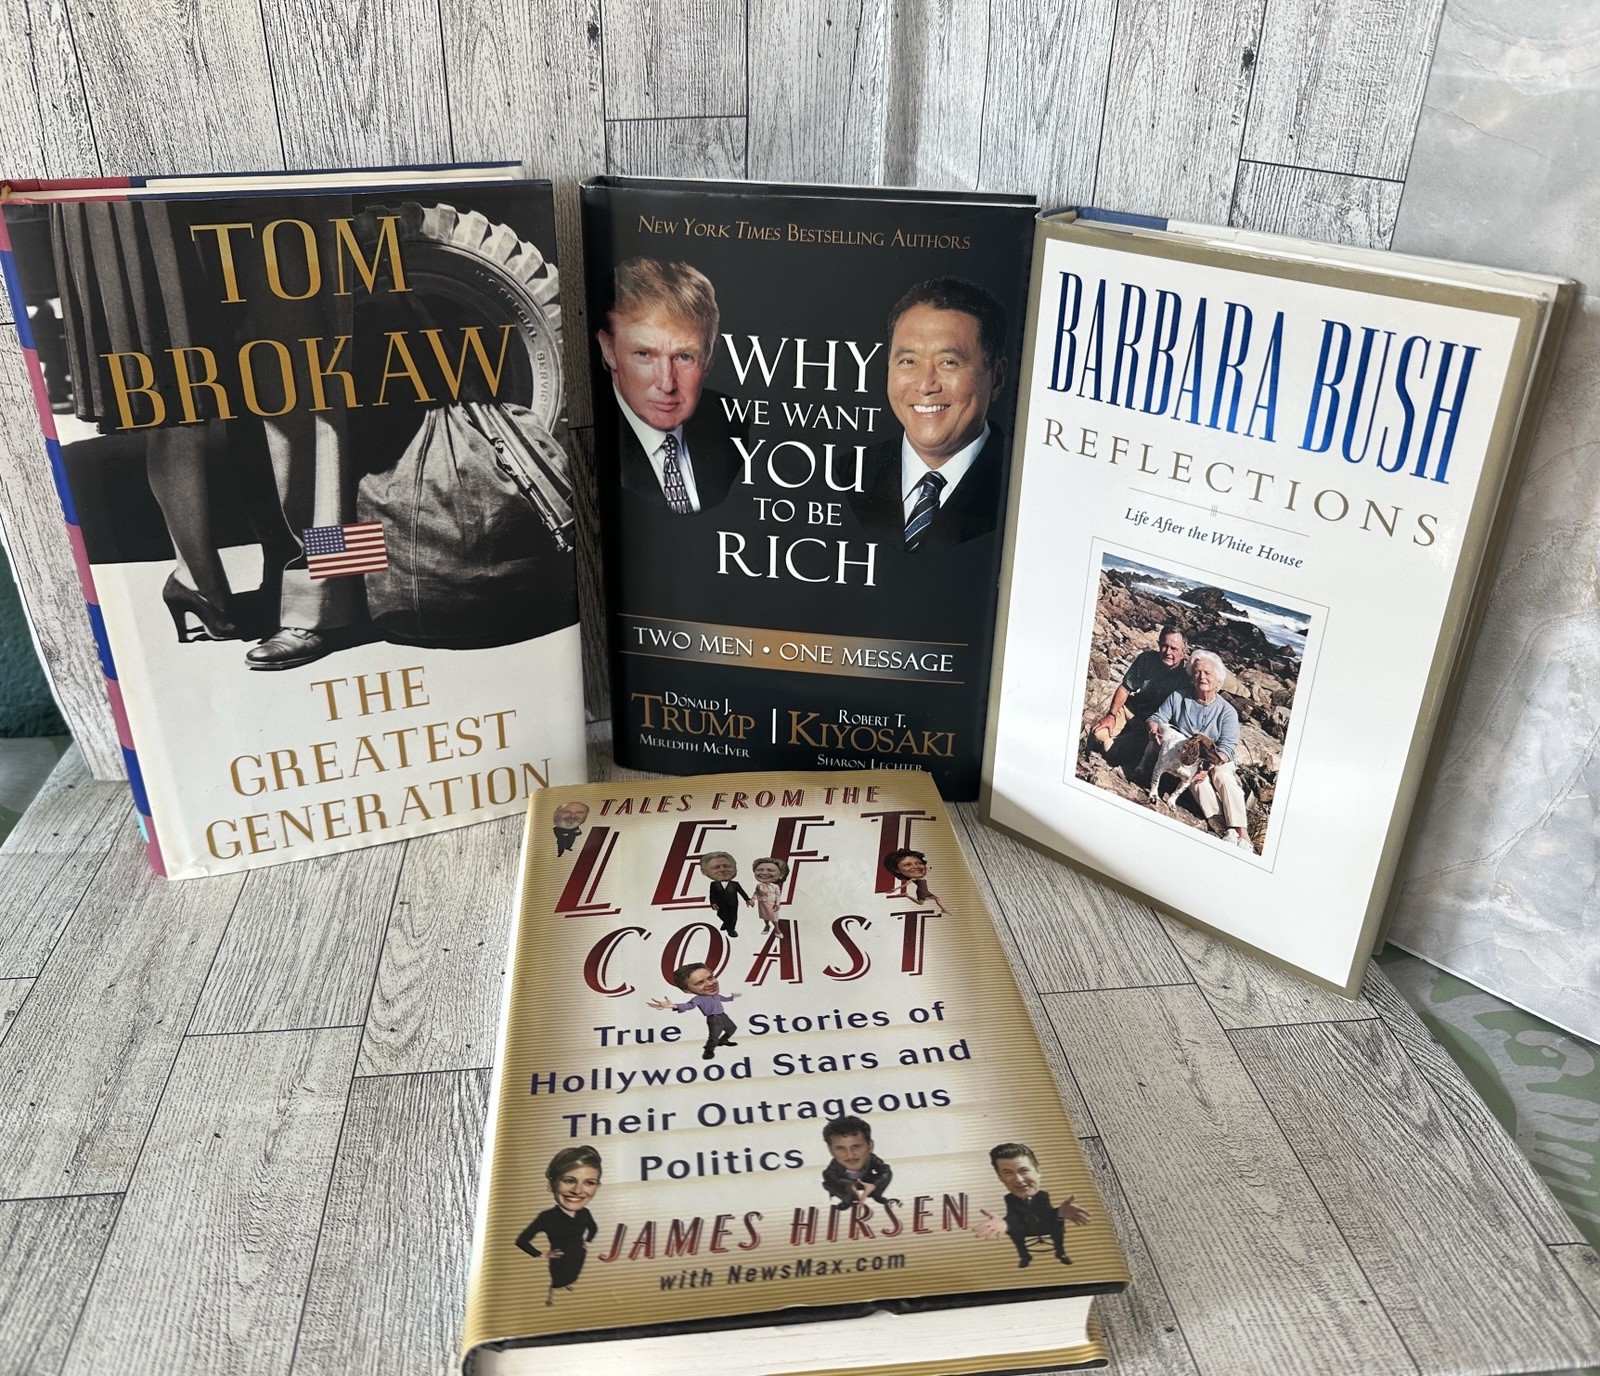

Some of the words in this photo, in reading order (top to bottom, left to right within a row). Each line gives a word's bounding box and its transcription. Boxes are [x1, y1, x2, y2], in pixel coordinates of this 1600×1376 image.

[190, 214, 413, 304] TOM
[638, 215, 679, 235] NEW
[682, 218, 730, 239] YORK
[735, 221, 781, 242] TIMES
[786, 224, 884, 247] BESTSELLING
[891, 229, 971, 250] AUTHORS
[100, 325, 516, 430] BROKAW
[721, 333, 883, 393] WHY
[1047, 271, 1285, 443] BARBARA
[1298, 318, 1482, 484] BUSH
[719, 397, 770, 425] WE
[780, 402, 882, 432] WANT
[730, 437, 867, 493] YOU
[1042, 417, 1439, 548] REFLECTIONS
[753, 497, 795, 522] TO
[808, 502, 842, 526] BE
[1125, 507, 1149, 526] Life
[1151, 516, 1185, 534] After
[1188, 526, 1208, 542] the
[1211, 531, 1253, 554] White
[1256, 544, 1303, 568] House
[716, 530, 878, 586] RICH
[633, 626, 691, 650] TWO
[699, 634, 753, 657] MEN
[779, 642, 833, 665] ONE
[841, 647, 953, 673] MESSAGE
[310, 665, 430, 722] THE
[631, 692, 756, 740] TRUMP
[665, 691, 720, 711] DONALD
[724, 698, 732, 715] J.
[838, 709, 889, 727] ROBERT
[894, 713, 907, 729] T.
[230, 709, 517, 796] GREATEST
[639, 734, 698, 752] MEREDITH
[788, 710, 956, 758] KIYOSAKI
[817, 753, 866, 769] SHARON
[206, 758, 552, 859] GENERATION
[600, 793, 694, 817] TALES
[711, 788, 806, 811] FROM
[823, 785, 881, 805] THE
[553, 810, 937, 919] LEFT
[583, 909, 943, 998] COAST
[594, 1024, 682, 1047] True
[748, 1009, 890, 1036] Stories
[909, 1000, 945, 1023] of
[530, 1056, 753, 1096] Hollywood
[772, 1046, 880, 1076] Stars
[899, 1038, 972, 1067] and
[562, 1106, 677, 1139] Their
[697, 1086, 952, 1129] Outrageous
[640, 1146, 805, 1182] Politics
[597, 1210, 763, 1264] JAMES
[790, 1191, 969, 1246] HIRSEN
[659, 1265, 713, 1291] with
[726, 1251, 906, 1285] NewsMax.com
